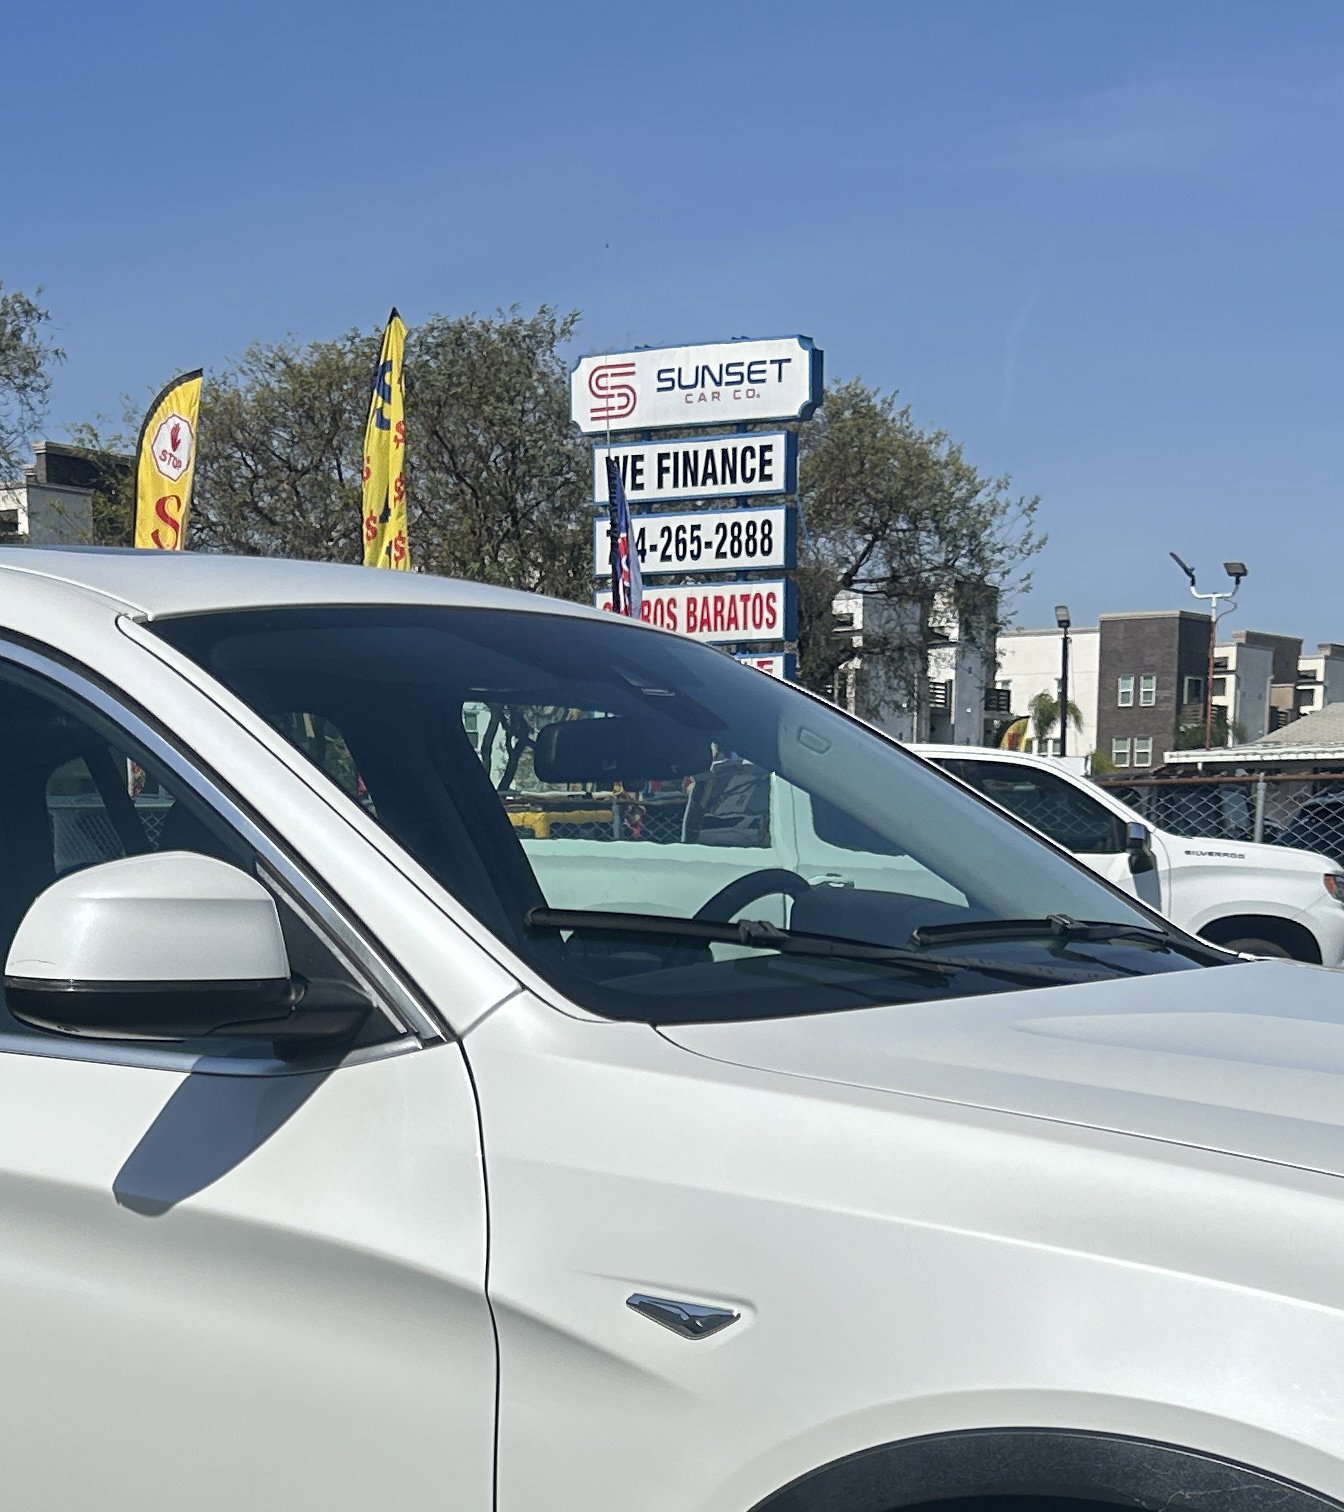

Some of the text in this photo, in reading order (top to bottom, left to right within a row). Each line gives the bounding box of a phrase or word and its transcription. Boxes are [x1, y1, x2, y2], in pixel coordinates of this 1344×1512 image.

[656, 358, 792, 392] SUNSET
[684, 388, 761, 404] CAR CO.
[657, 444, 773, 490] FINANCE
[606, 518, 773, 565] 4-265-2888
[686, 591, 777, 634] BARATOS
